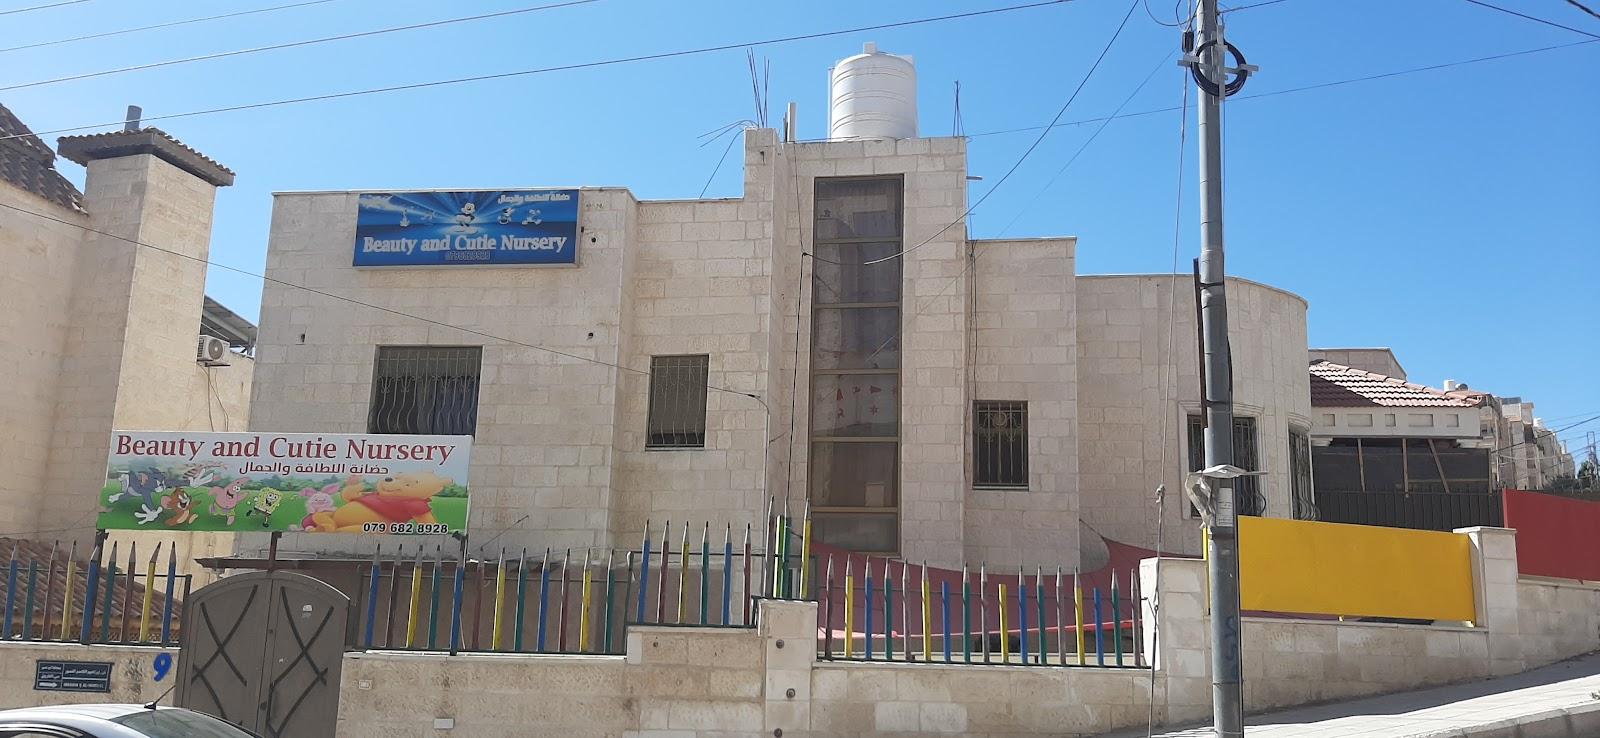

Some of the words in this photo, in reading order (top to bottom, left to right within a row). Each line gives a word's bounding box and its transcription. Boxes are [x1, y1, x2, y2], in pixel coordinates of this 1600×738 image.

[363, 236, 418, 255] Beauty
[420, 234, 450, 251] and
[455, 234, 497, 251] Cutie
[501, 234, 568, 253] Nursery
[115, 434, 205, 461] Beauty
[211, 436, 260, 458] and
[269, 437, 337, 459] Cutie
[345, 439, 456, 466] Nursery
[238, 461, 291, 476] والجمال
[295, 463, 345, 474] اللطافة
[349, 463, 389, 475] حضانة
[363, 522, 386, 533] 079
[390, 523, 413, 534] 682
[417, 524, 449, 534] 8928
[153, 652, 173, 682] 9
